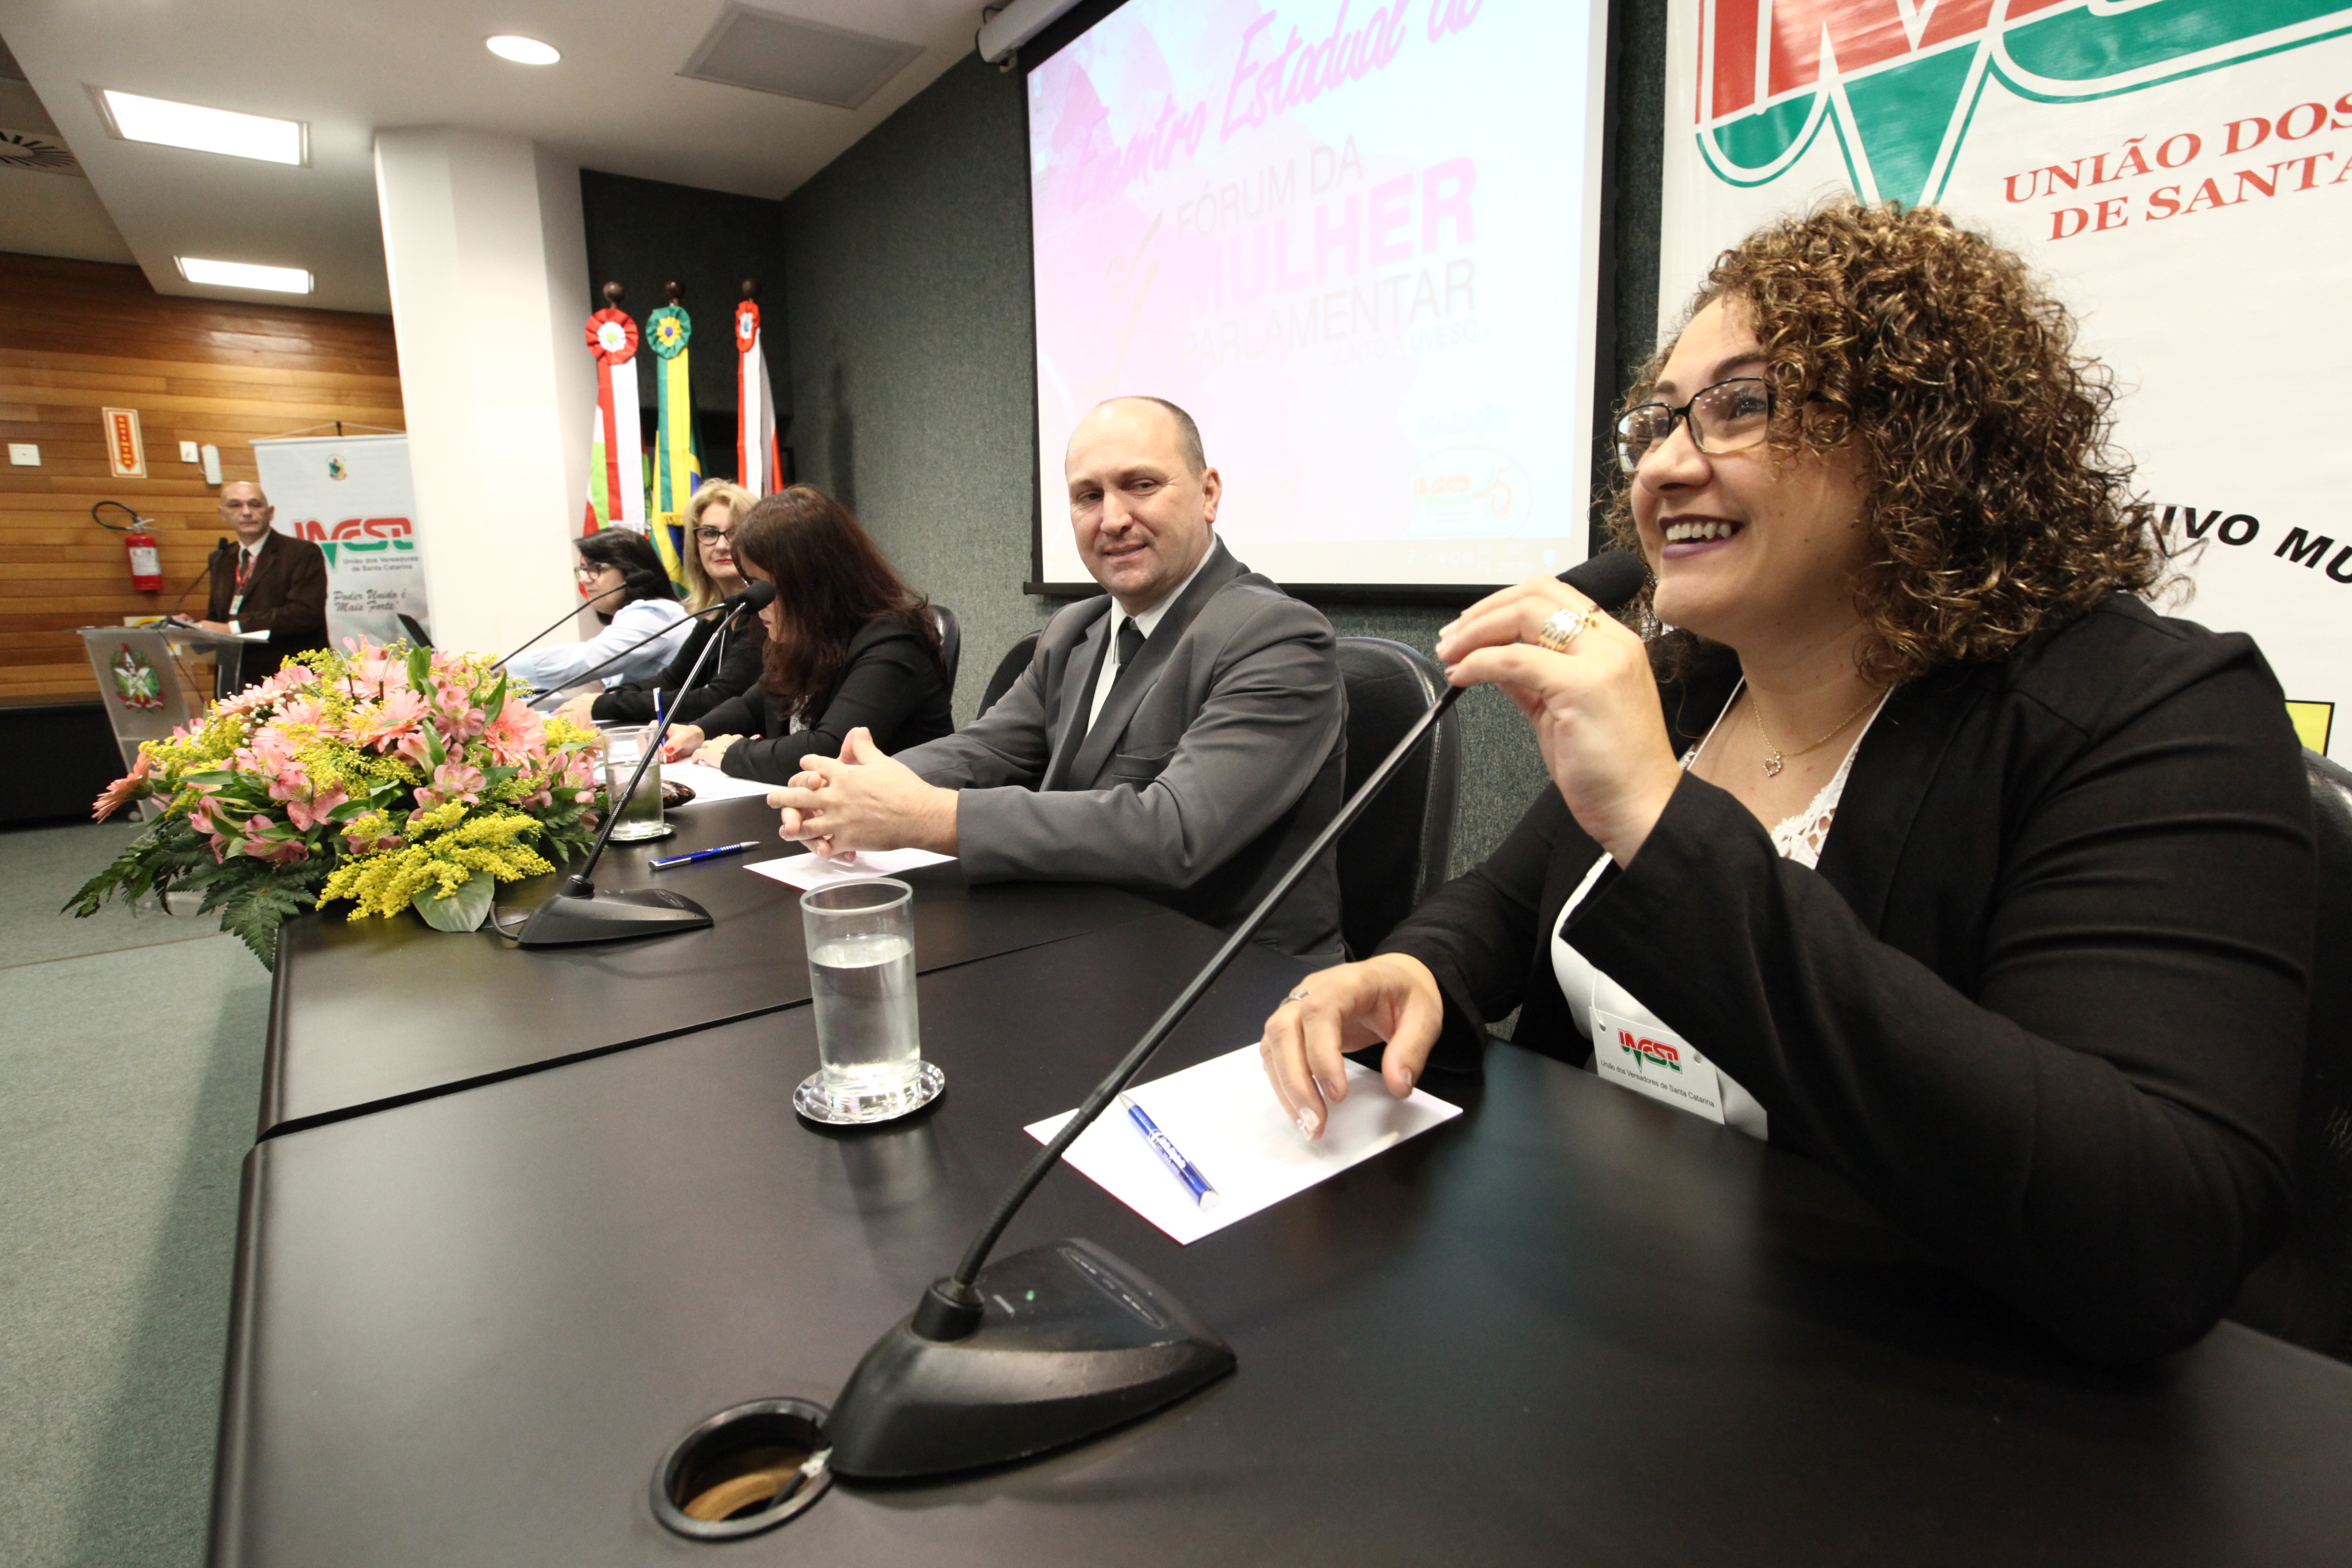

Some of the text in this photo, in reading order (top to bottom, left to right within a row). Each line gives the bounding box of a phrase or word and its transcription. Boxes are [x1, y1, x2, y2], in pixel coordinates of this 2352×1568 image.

[1177, 134, 1363, 242] FÓRUM DA
[2003, 134, 2202, 203] UNIÃO
[1179, 156, 1476, 323] MULHER
[2046, 196, 2128, 241] DE
[1179, 257, 1475, 374] PARLAMENTAR
[1328, 337, 1388, 369] JUNTO
[1409, 318, 1479, 353] UVESC
[1600, 1058, 1715, 1107] União dos Vereadores de Santa Catarina
